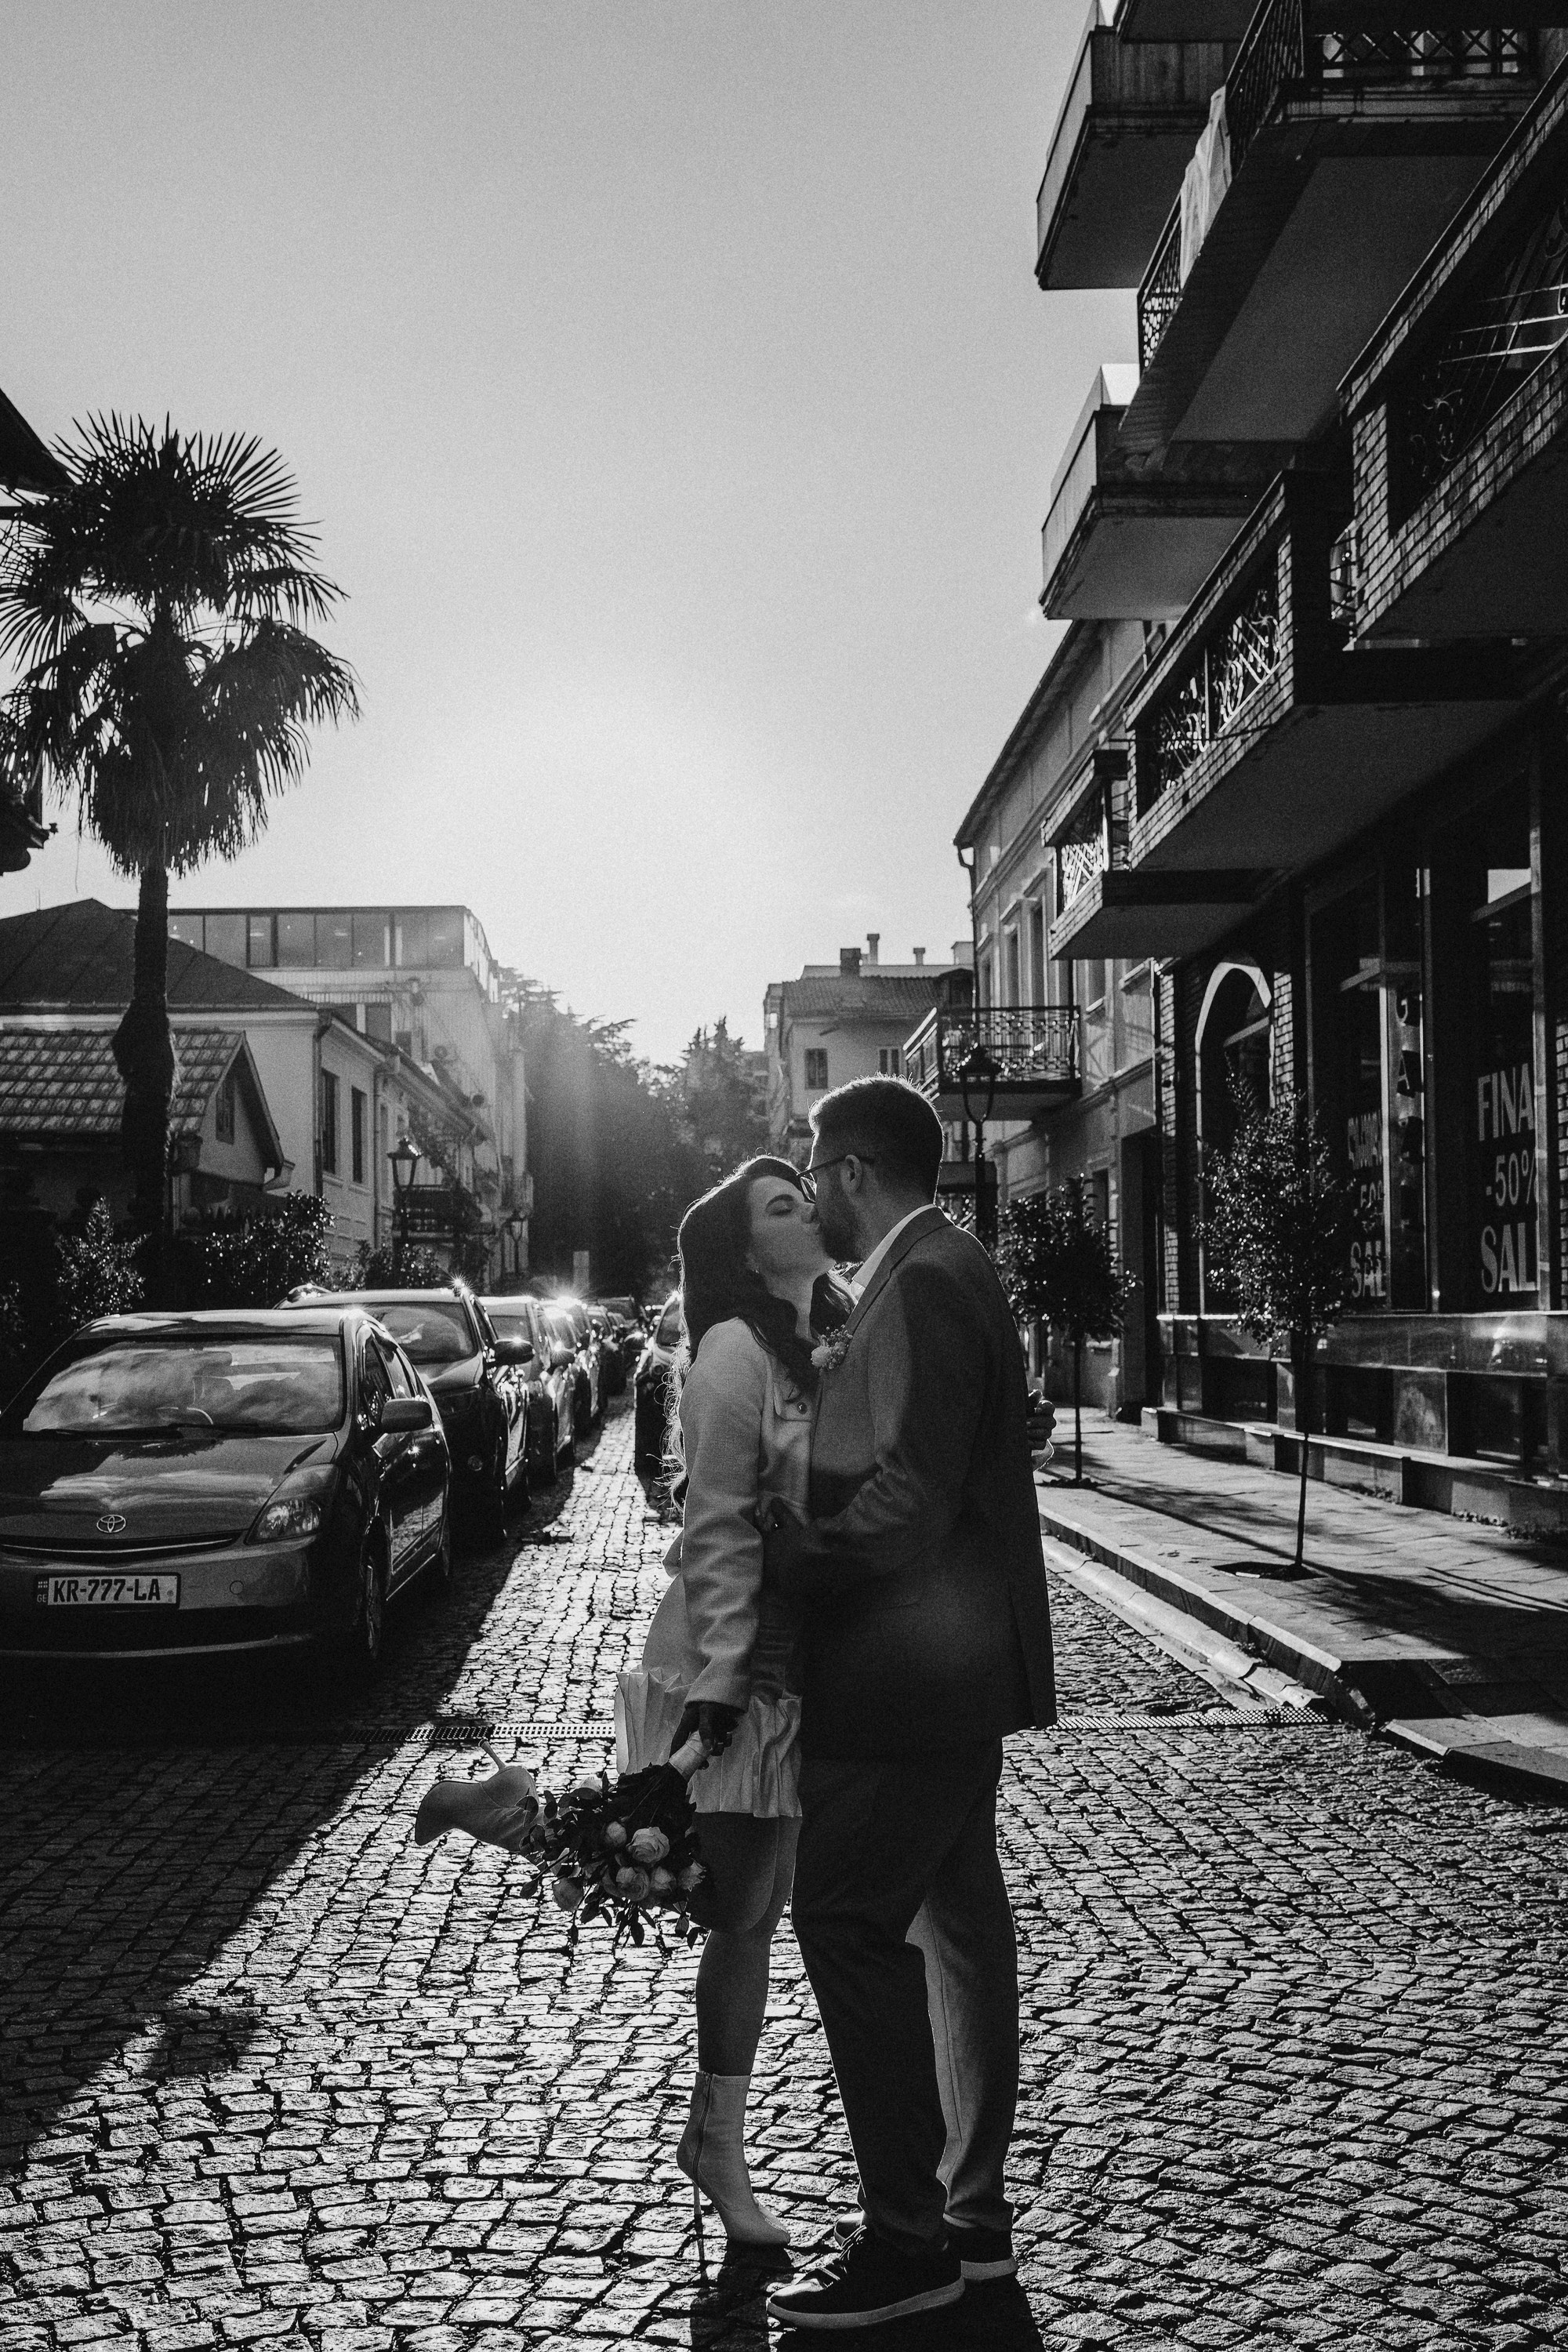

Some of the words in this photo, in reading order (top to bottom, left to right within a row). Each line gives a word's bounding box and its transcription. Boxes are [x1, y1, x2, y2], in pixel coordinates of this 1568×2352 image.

[1481, 1220, 1540, 1294] SAL
[36, 1594, 48, 1603] GE
[53, 1578, 161, 1602] KR-777-LA
